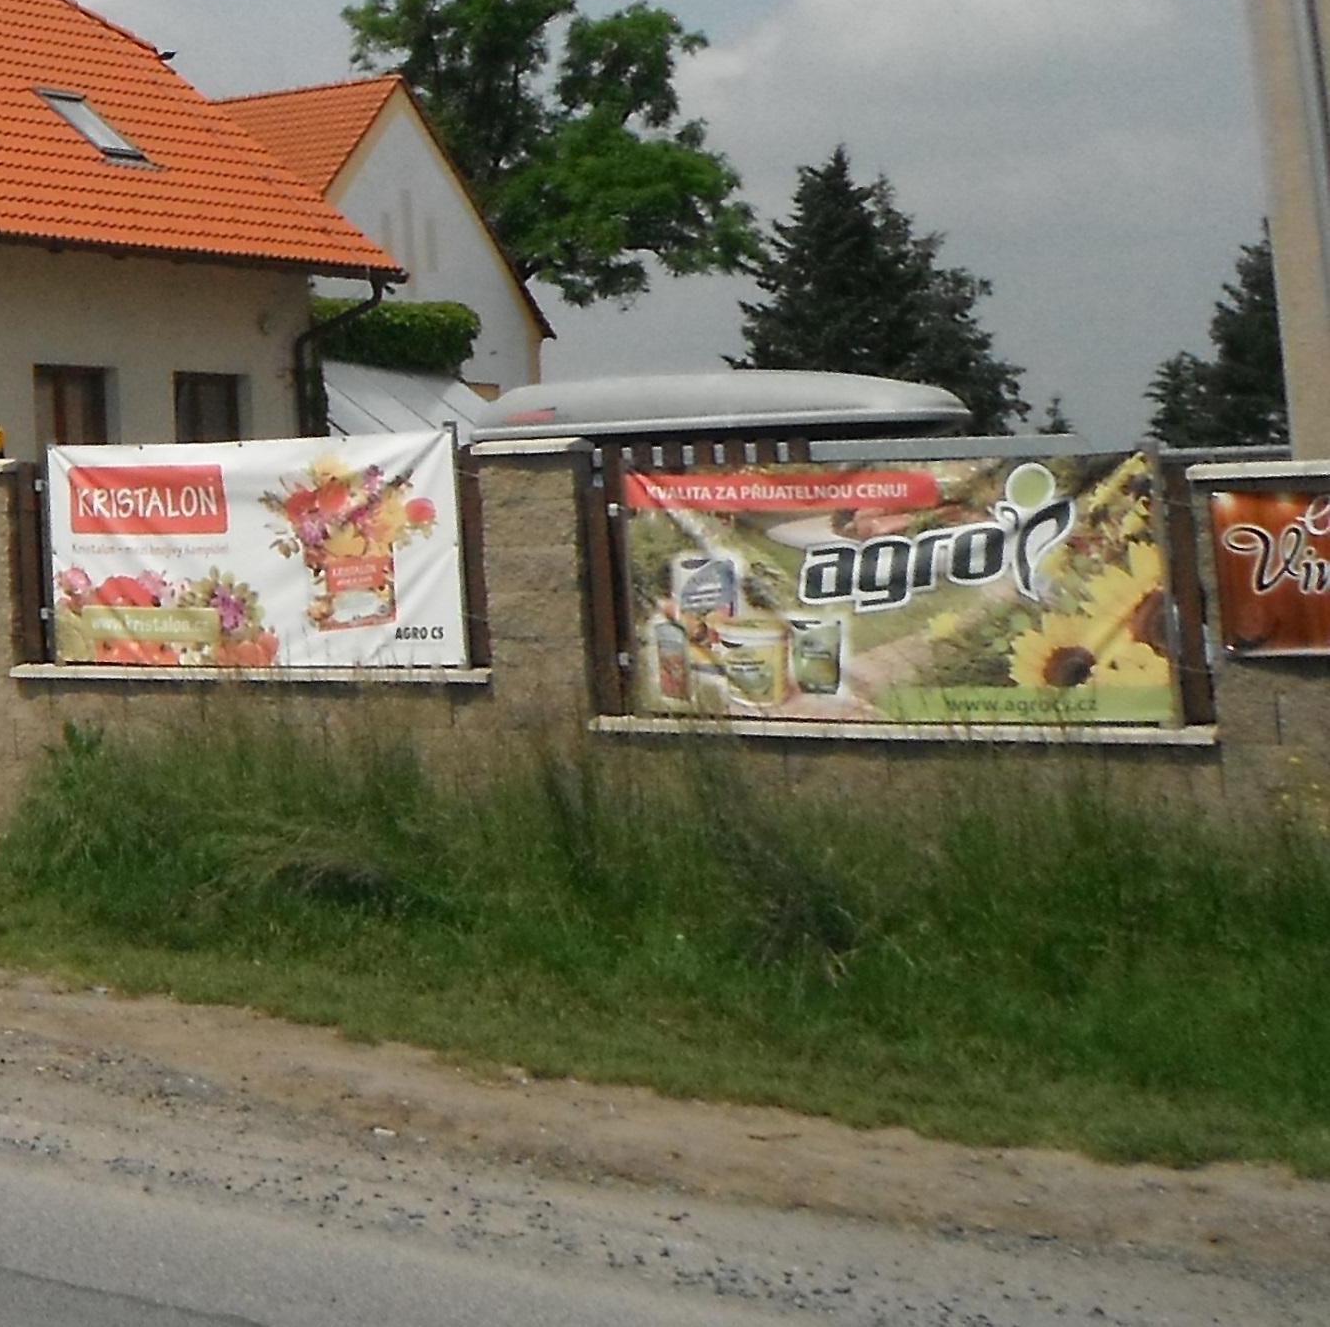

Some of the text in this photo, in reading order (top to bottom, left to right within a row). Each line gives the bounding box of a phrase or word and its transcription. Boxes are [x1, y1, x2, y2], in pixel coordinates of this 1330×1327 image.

[646, 482, 909, 501] KVALITA ZA PŘIJATELNOU CENU!
[77, 485, 219, 519] KRISTALON
[395, 626, 445, 641] AGRO CS
